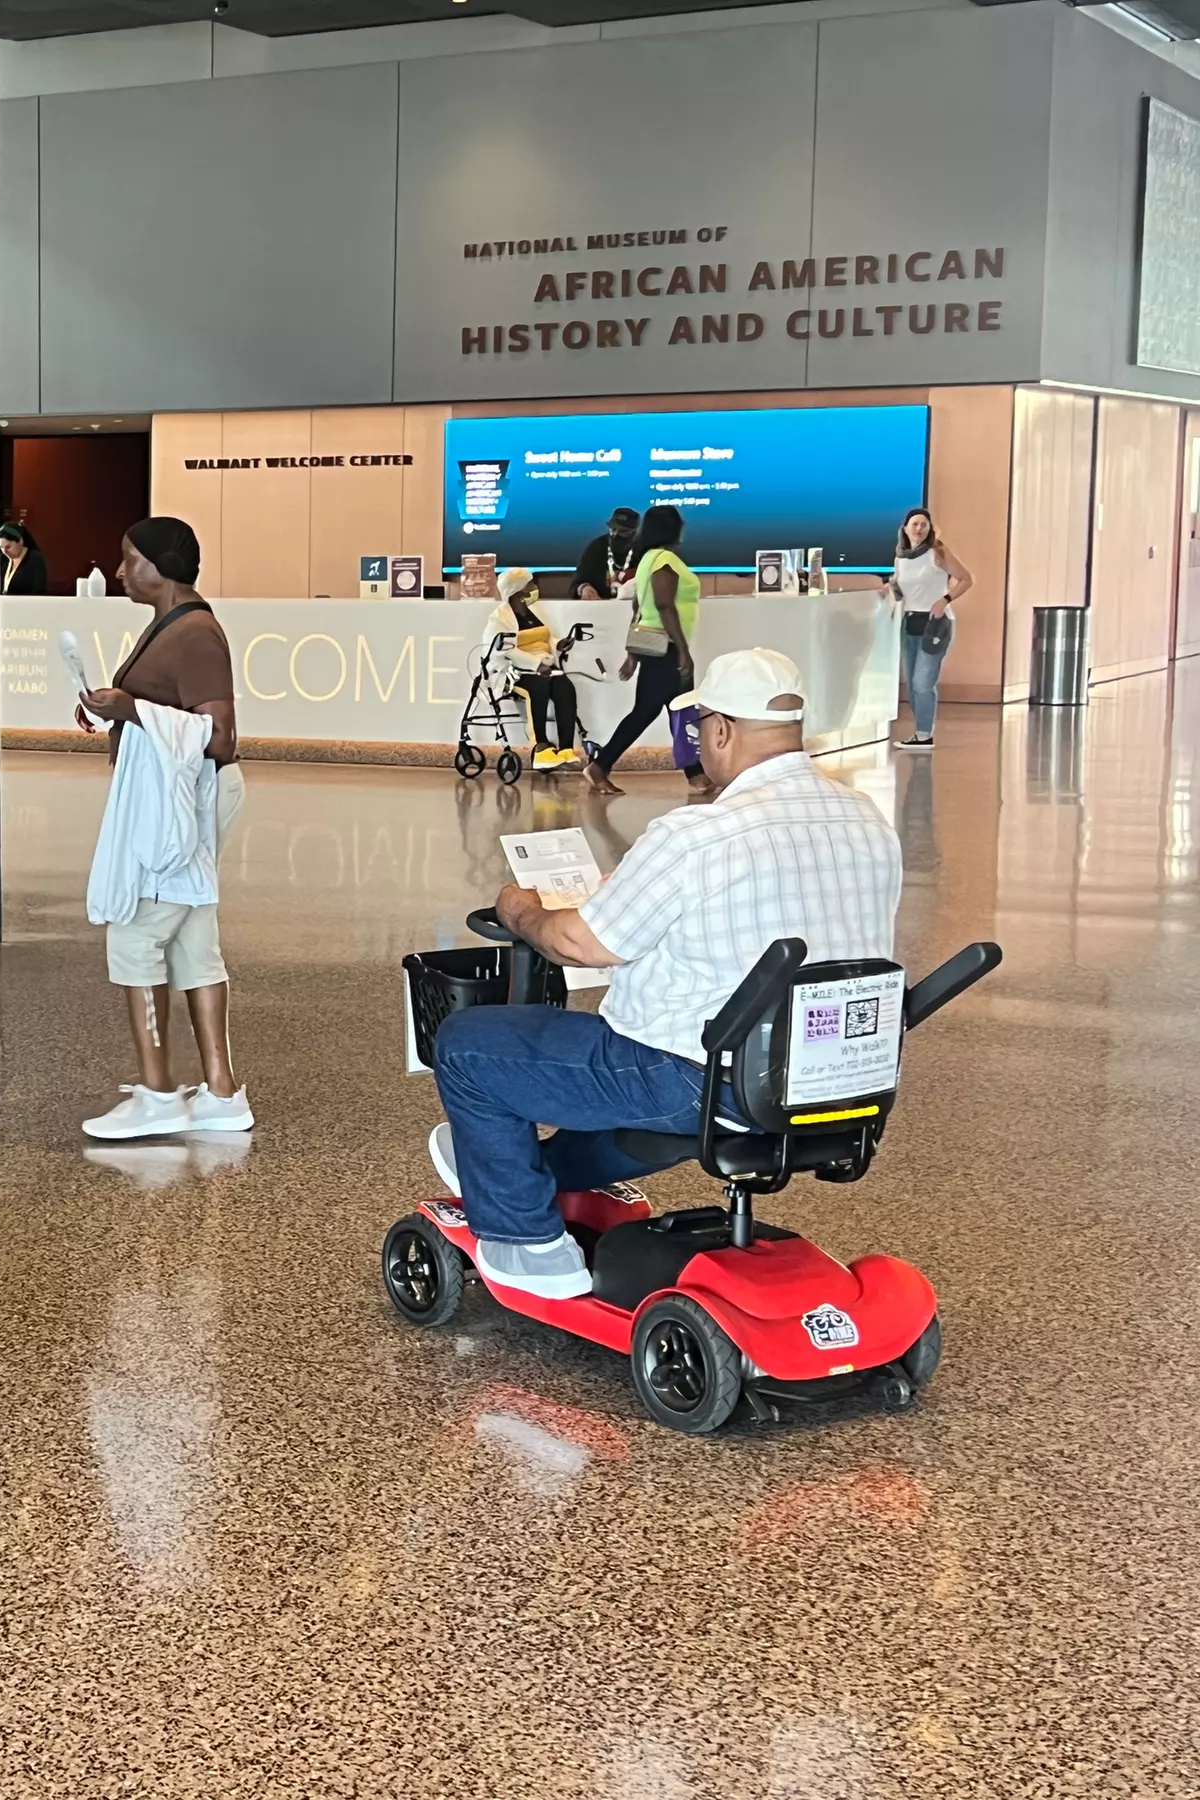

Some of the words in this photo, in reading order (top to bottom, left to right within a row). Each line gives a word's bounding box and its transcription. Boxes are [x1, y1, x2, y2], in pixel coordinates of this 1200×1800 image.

[463, 236, 578, 259] NATIONAL
[586, 229, 688, 250] MUSEUM
[697, 226, 728, 244] OF
[533, 263, 728, 303] AFRICAN
[747, 247, 1005, 292] AMERICAN
[461, 317, 650, 355] HISTORY
[667, 312, 765, 346] AND
[785, 300, 1002, 341] CULTURE
[184, 457, 261, 469] WALMART
[265, 455, 345, 468] WELCOME
[349, 454, 414, 466] CENTER
[93, 630, 466, 704] WCOME
